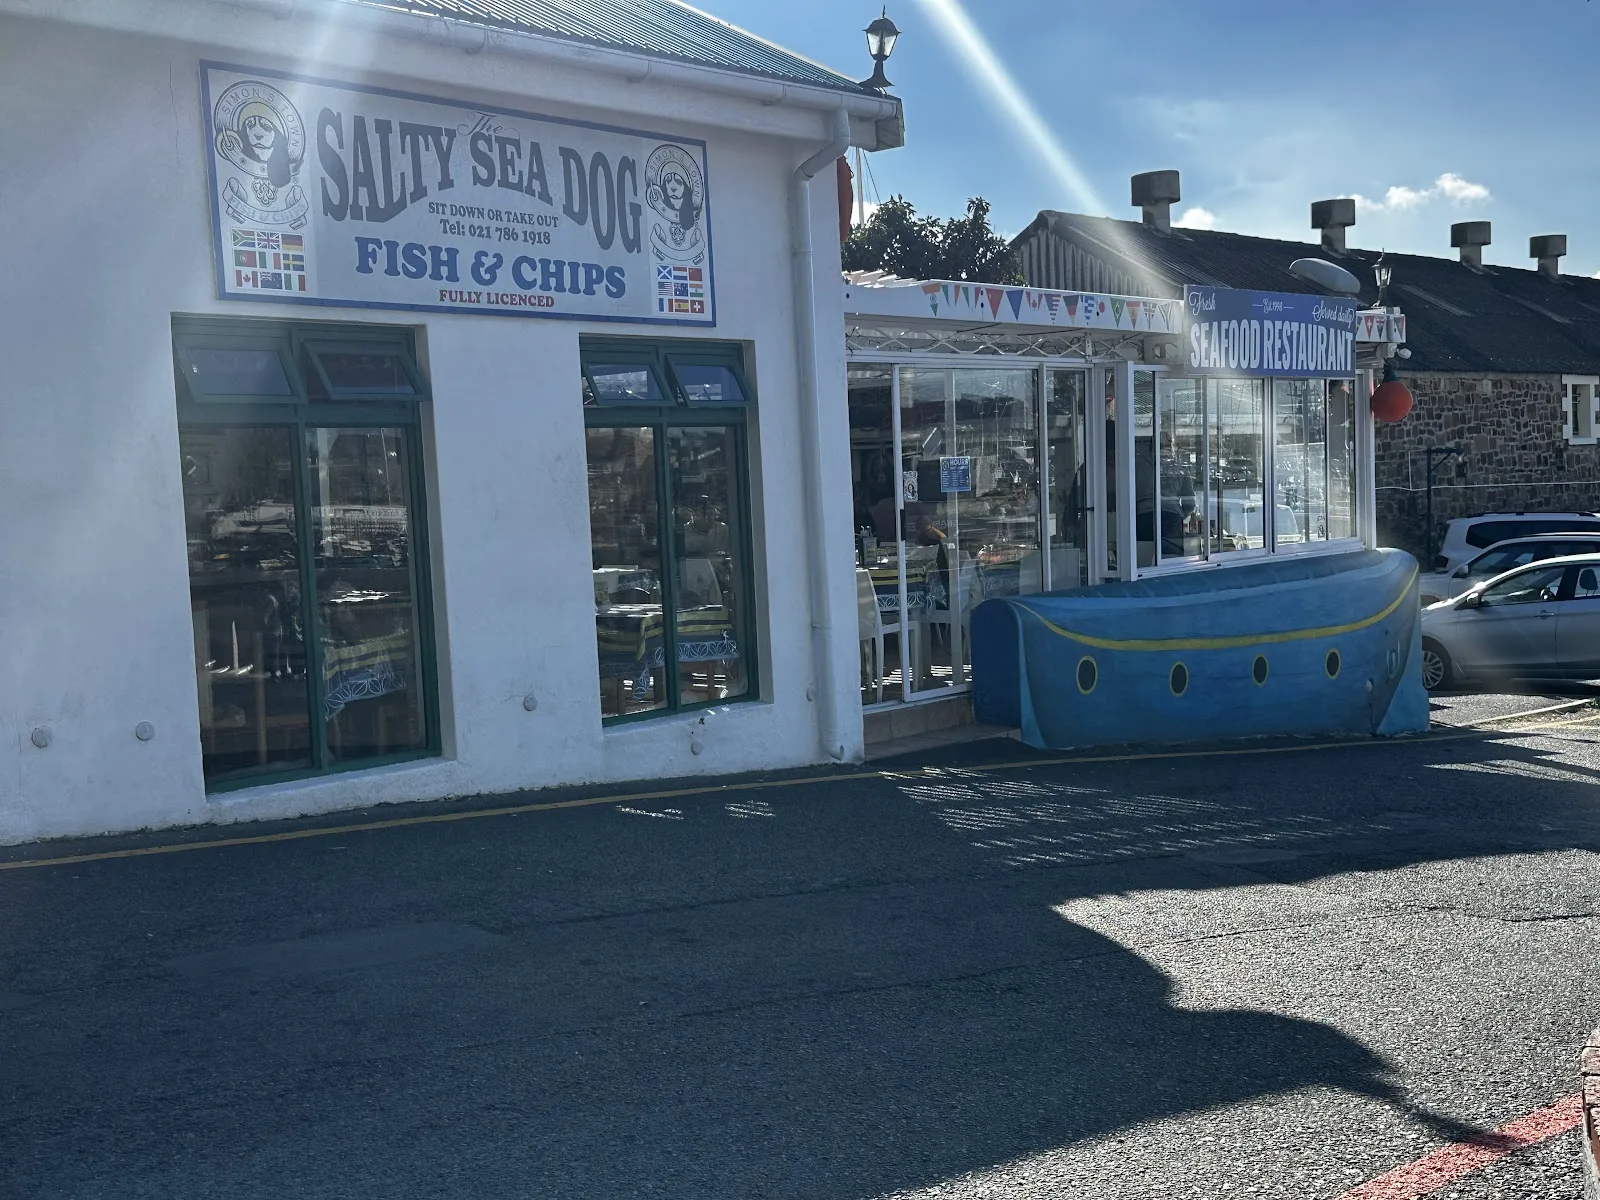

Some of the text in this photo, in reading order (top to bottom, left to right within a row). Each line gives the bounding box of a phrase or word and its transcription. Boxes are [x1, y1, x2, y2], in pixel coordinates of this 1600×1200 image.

[282, 103, 300, 147] TOWN
[457, 110, 520, 137] The
[316, 107, 642, 254] SALTY SEA DOG
[687, 163, 701, 198] TOWN
[428, 201, 559, 228] SIT DOWN OR TAKE OUT
[439, 218, 551, 245] Tel: 021 786 1918
[354, 236, 626, 299] FISH & CHIPS
[438, 289, 555, 308] FULLY LICENCED
[1188, 291, 1216, 316] Fresh
[1311, 300, 1355, 330] Served daily
[1190, 319, 1354, 371] SEAFOOD RESTAURANT
